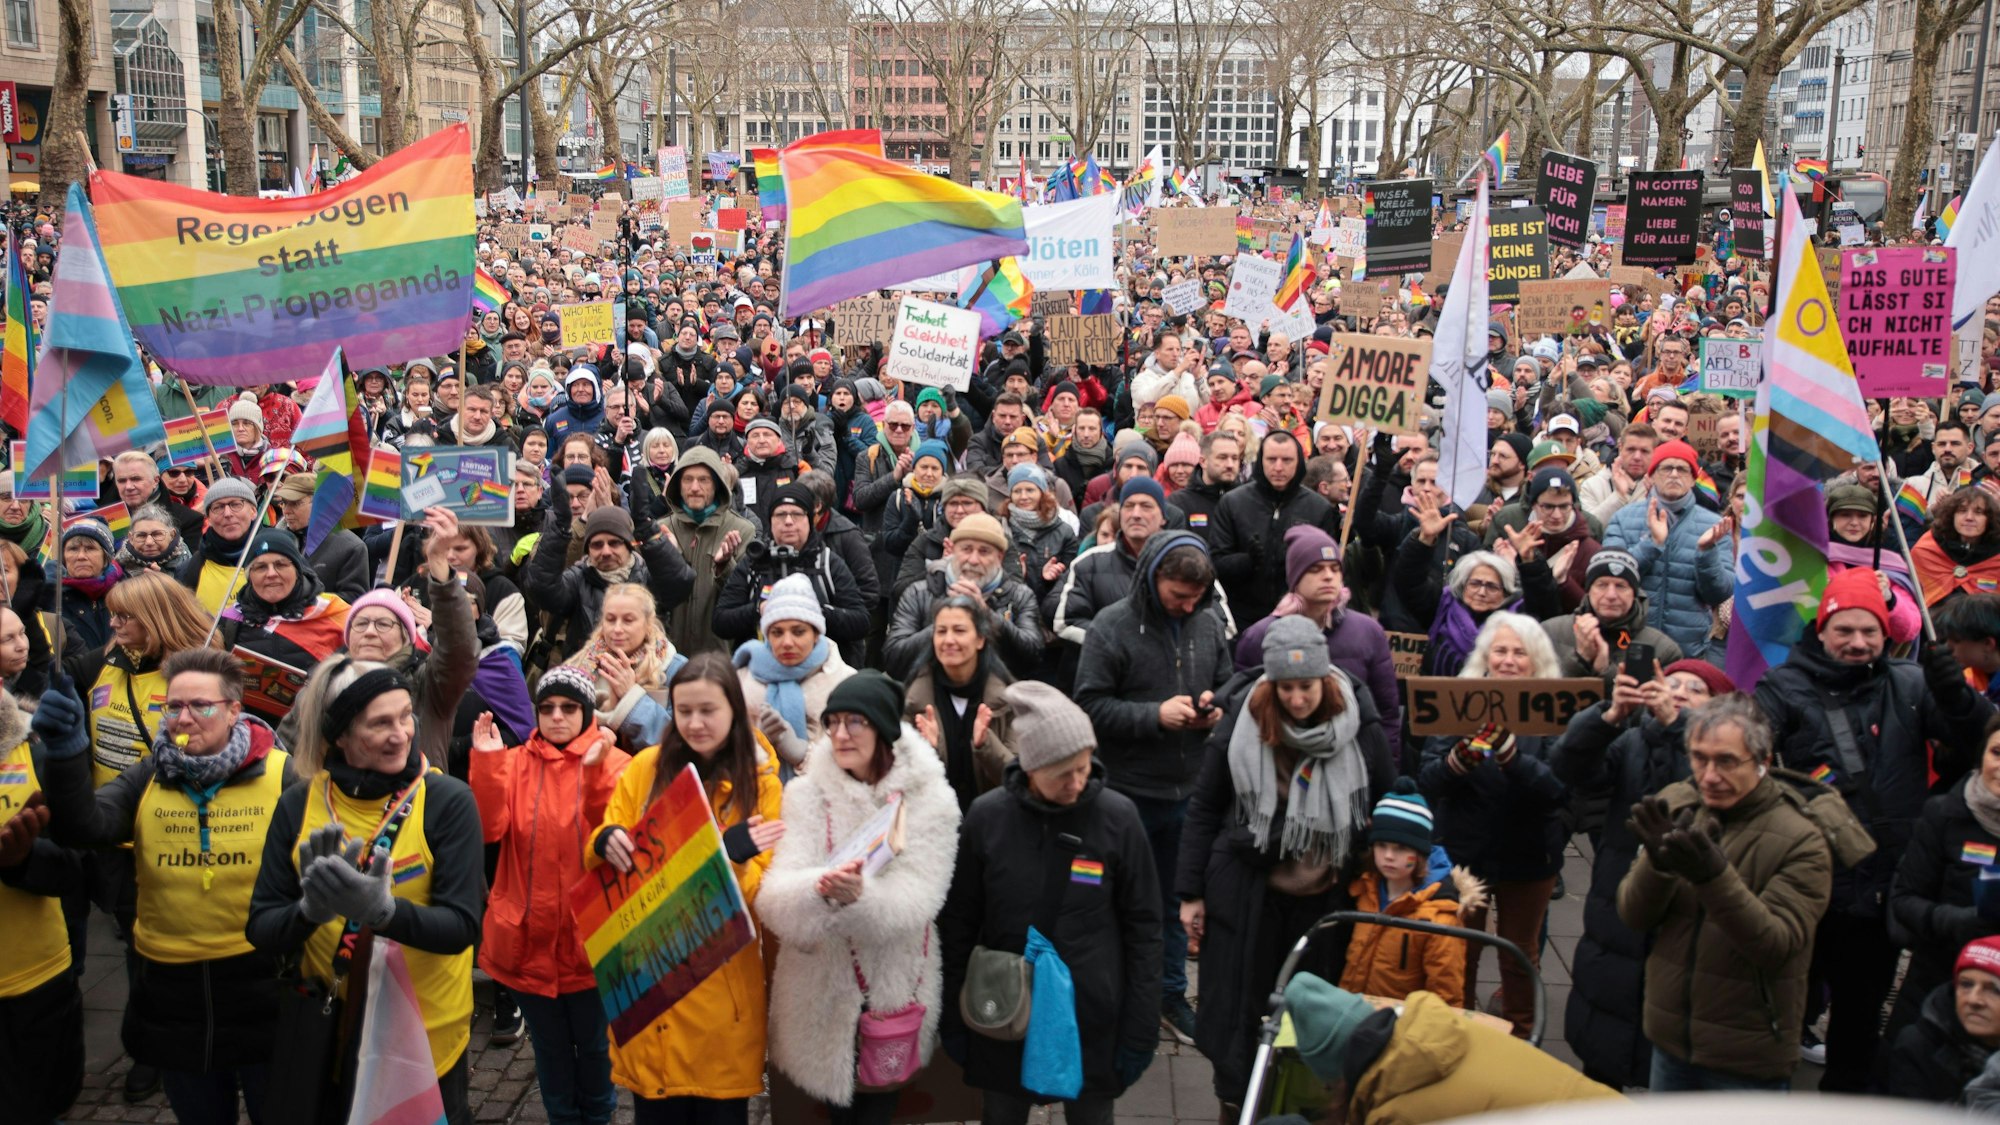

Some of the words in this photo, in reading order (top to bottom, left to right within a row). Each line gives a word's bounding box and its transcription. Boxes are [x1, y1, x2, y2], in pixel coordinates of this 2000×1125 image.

[663, 172, 685, 181] UND
[1545, 160, 1585, 185] LIEBE
[1635, 181, 1649, 191] IN
[1652, 180, 1698, 190] GOTTES
[1738, 184, 1753, 195] GOD
[1374, 189, 1409, 199] UNSER
[1549, 186, 1578, 209] FÜR
[1641, 197, 1686, 207] NAMEN:
[1380, 199, 1414, 208] KREUZ
[1733, 201, 1750, 212] MADE
[1751, 202, 1761, 213] ME
[176, 190, 410, 246] Regebogen
[1373, 210, 1391, 219] HAT
[1394, 208, 1429, 218] KEINEN
[1377, 218, 1413, 227] HAKEN
[1488, 223, 1518, 238] IEBE
[1523, 221, 1545, 235] IST
[1646, 219, 1677, 228] LIEBE
[1733, 218, 1746, 229] THIS
[1746, 219, 1763, 230] WAY!
[1634, 232, 1656, 244] FÜR
[1659, 235, 1690, 244] ALLE!
[1022, 236, 1099, 261] löten
[1492, 243, 1534, 259] KEINE
[257, 237, 343, 277] statt
[692, 255, 715, 264] MERZ
[1074, 264, 1099, 277] Köln
[1487, 264, 1541, 280] SÜNDE!
[1851, 270, 1887, 288] DAS
[1901, 268, 1948, 287] GUTE
[157, 264, 461, 335] Nazi-Propaganda
[838, 301, 873, 312] HASS
[1849, 290, 1909, 310] LÄSST
[1922, 292, 1946, 310] SI
[562, 306, 583, 317] WHO
[586, 305, 603, 314] THE
[904, 304, 948, 328] Freiheit
[838, 314, 880, 328] JETZT
[1050, 316, 1080, 340] LAUT
[1084, 315, 1113, 338] SEIN
[1848, 316, 1872, 334] CH
[1885, 315, 1944, 333] NICHT
[567, 333, 578, 344] IS
[582, 328, 614, 342] ALICE?
[838, 329, 883, 344] PAUSE
[903, 324, 968, 351] Gleichheit
[1050, 339, 1082, 366] GEGEN
[1085, 337, 1118, 363] RECHTS
[1707, 343, 1733, 356] DAS
[1848, 338, 1942, 357] AUFHALTE
[1959, 340, 1979, 354] TT
[899, 342, 969, 370] Solidarität
[1705, 357, 1733, 370] AFD
[1336, 345, 1421, 386] AMORE
[1328, 384, 1405, 427] DIGGA
[110, 701, 146, 717] rubicn.
[1413, 690, 1440, 724] 5
[1449, 690, 1508, 722] VOR
[154, 807, 197, 819] Queere
[208, 806, 265, 818] olidarität
[165, 823, 196, 834] ohne
[209, 822, 254, 833] renzen!
[157, 847, 253, 867] rubicon.
[599, 817, 667, 912] HASS
[618, 907, 638, 930] ist
[638, 876, 667, 910] keine
[606, 860, 734, 1019] MEINUNG!
